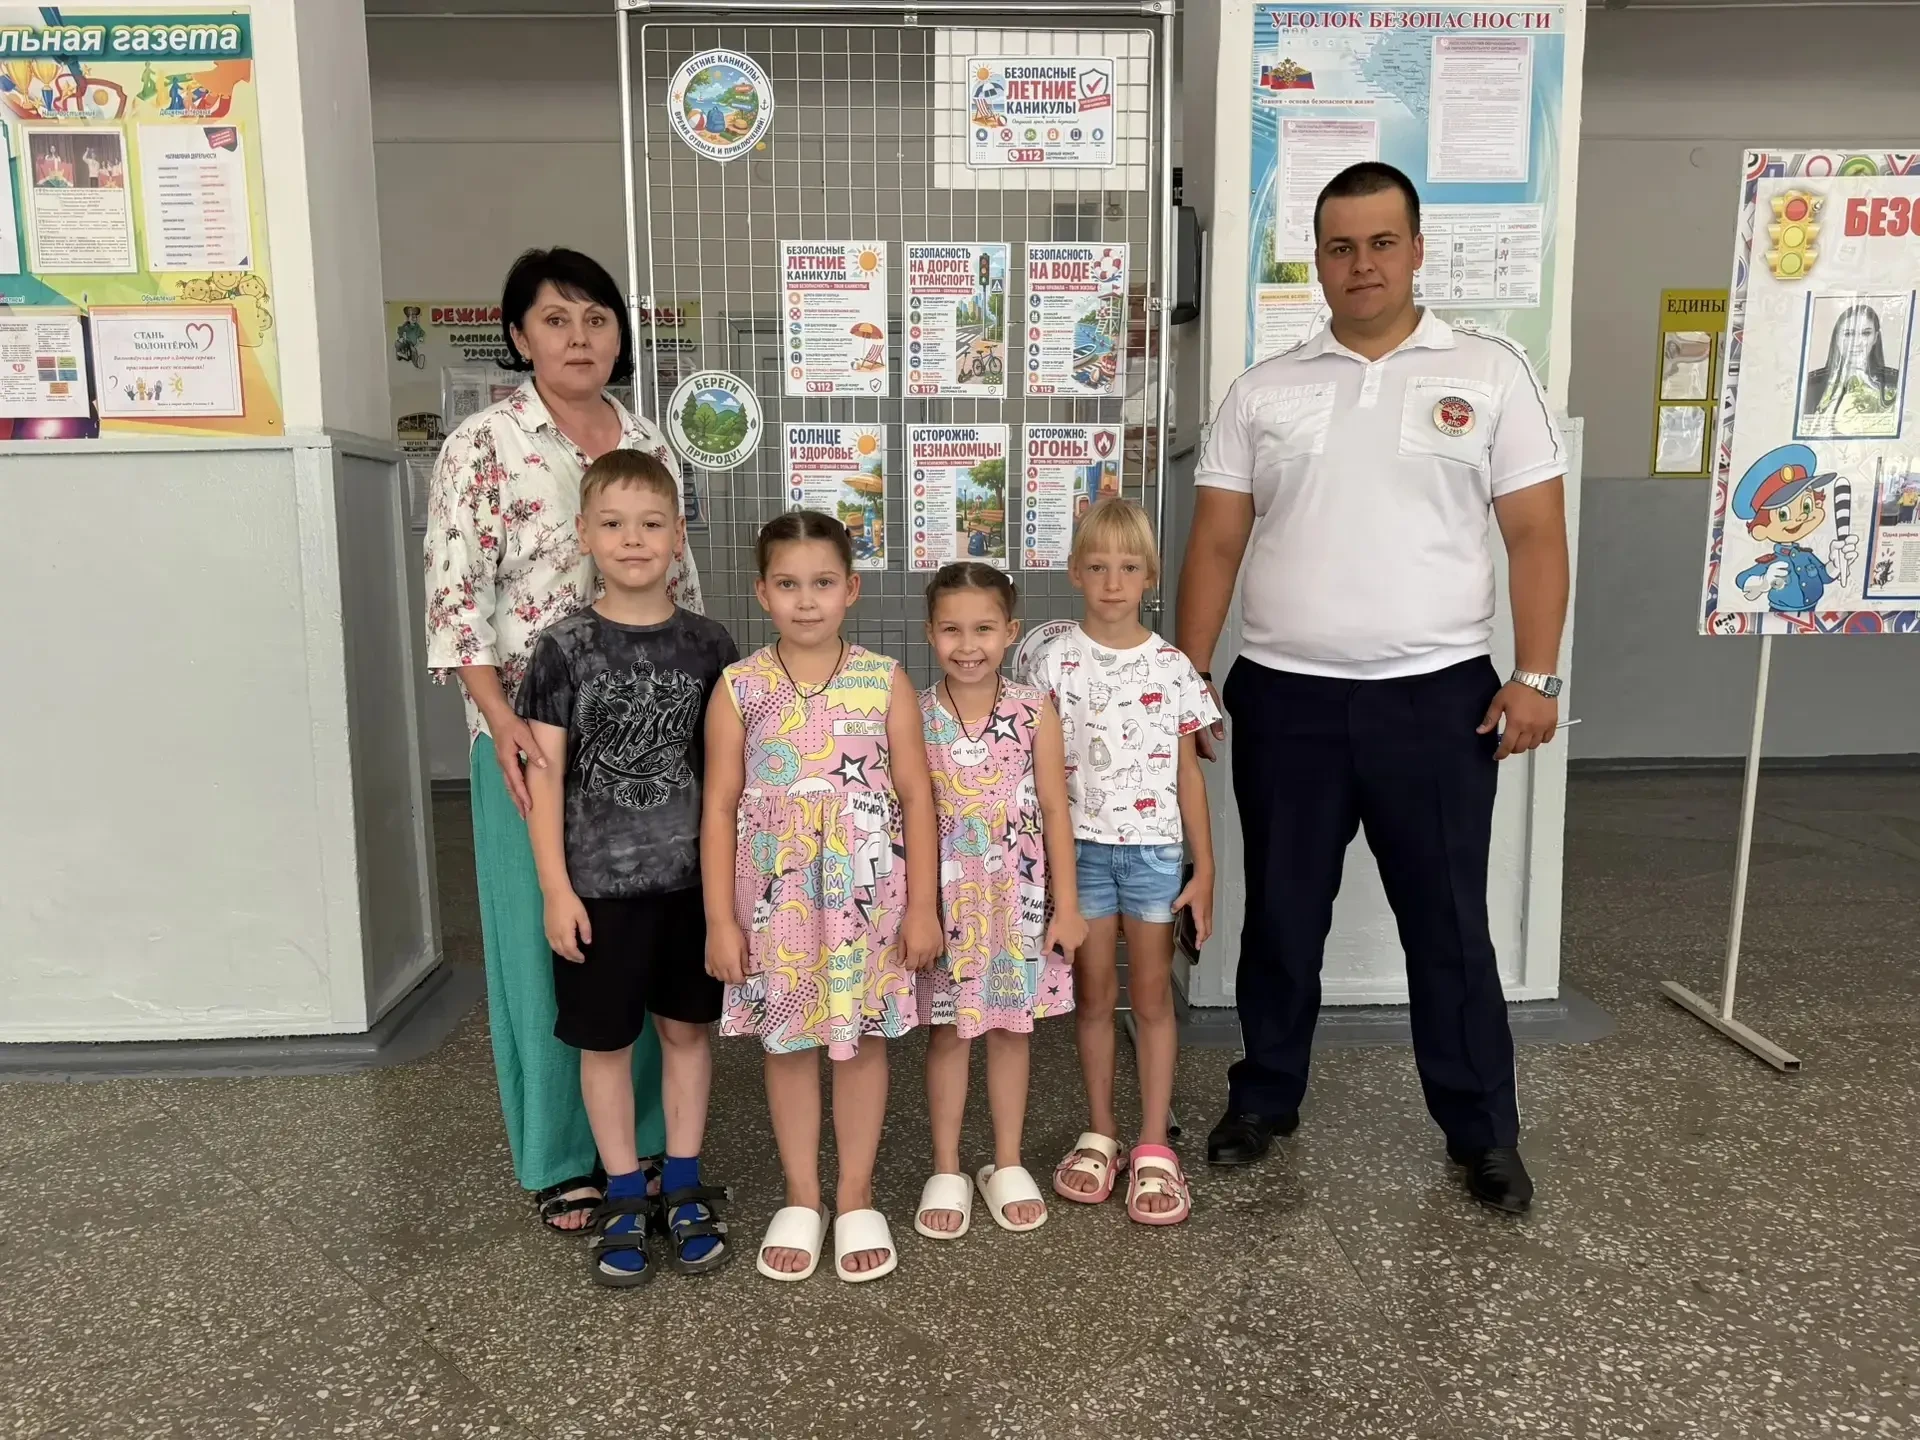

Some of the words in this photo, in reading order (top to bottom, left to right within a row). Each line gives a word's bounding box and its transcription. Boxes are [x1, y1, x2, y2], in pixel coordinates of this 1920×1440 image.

[1270, 11, 1364, 29] УГОЛОК
[1368, 11, 1551, 30] БЕЗОПАСНОСТИ
[113, 28, 239, 53] газета
[685, 57, 716, 77] ЛЕТНИЕ
[717, 54, 760, 82] КАНИКУЛЫ
[1004, 67, 1077, 79] БЕЗОПАСНЫЕ
[1005, 80, 1077, 100] ЛЕТНИЕ
[1006, 101, 1077, 115] КАНИКУЛЫ
[674, 111, 690, 135] ВРЕМЯ
[689, 135, 716, 154] ОТДЫХА
[724, 117, 766, 155] ПРИКЛЮЧЕНИЙ!
[1021, 150, 1042, 161] 112
[786, 245, 846, 255] БЕЗОПАСНЫЕ
[909, 247, 972, 259] БЕЗОПАСНОСТЬ
[1029, 248, 1094, 261] БЕЗОПАСНОСТЬ
[786, 256, 847, 271] ЛЕТНИЕ
[909, 260, 924, 273] НА
[927, 259, 969, 274] ДОРОГЕ
[786, 270, 847, 281] КАНИКУЛЫ
[1029, 262, 1048, 280] НА
[1052, 262, 1090, 282] ВОДЕ
[909, 274, 916, 287] И
[918, 274, 975, 287] ТРАНСПОРТЕ
[133, 331, 165, 340] СТАНЬ
[134, 340, 199, 351] ВОЛОНТЁРОМ
[463, 347, 510, 360] УРОКОВ
[693, 377, 741, 395] БЕРЕГИ
[816, 382, 832, 392] 112
[920, 385, 936, 394] 112
[1446, 418, 1462, 428] ДПС
[789, 428, 842, 447] СОЛНЦЕ
[912, 429, 979, 442] ОСТОРОЖНО:
[1028, 428, 1088, 440] ОСТОРОЖНО:
[790, 446, 797, 460] И
[799, 446, 854, 462] ЗДОРОВЬЕ
[912, 442, 1002, 459] НЕЗНАКОМЦЫ!
[1028, 440, 1089, 457] ОГОНЬ!
[685, 445, 744, 466] ПРИРОДУ!
[923, 560, 937, 568] 112
[1035, 560, 1048, 568] 112
[1112, 805, 1128, 813] MEOW
